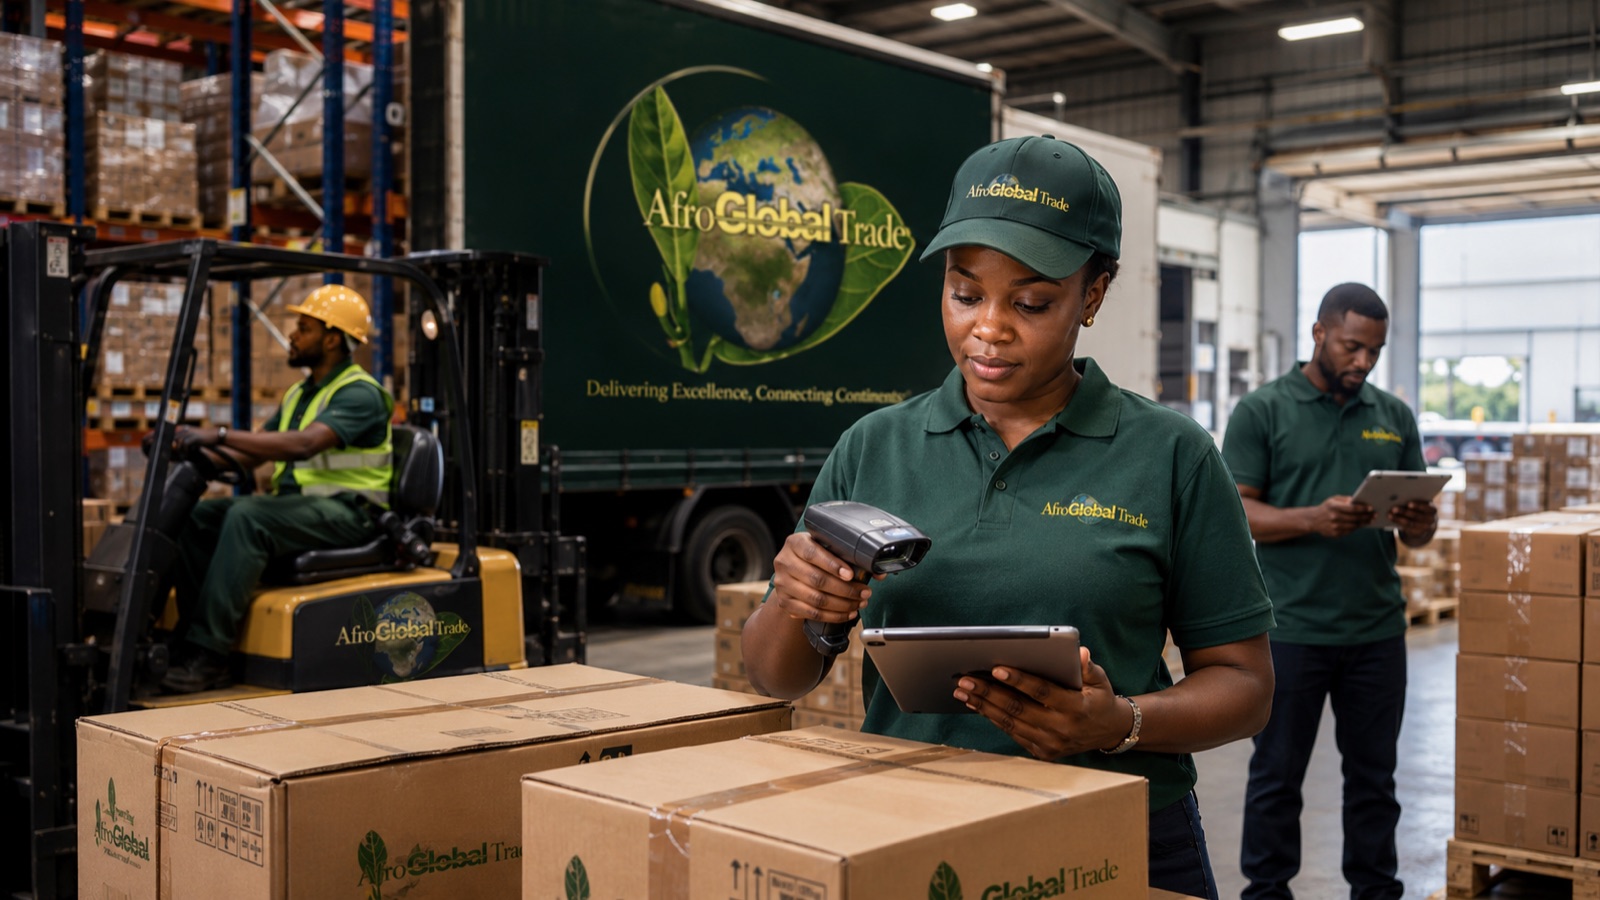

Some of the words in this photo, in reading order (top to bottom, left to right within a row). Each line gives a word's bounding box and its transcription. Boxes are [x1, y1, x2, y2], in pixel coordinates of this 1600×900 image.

[1040, 191, 1070, 212] Trade
[833, 208, 910, 250] Trade
[586, 379, 669, 403] Delivering
[672, 382, 753, 403] Excellence,
[755, 384, 834, 406] Connecting
[1117, 507, 1149, 529] Trade
[434, 619, 469, 636] Trade
[1068, 858, 1119, 890] Trade
